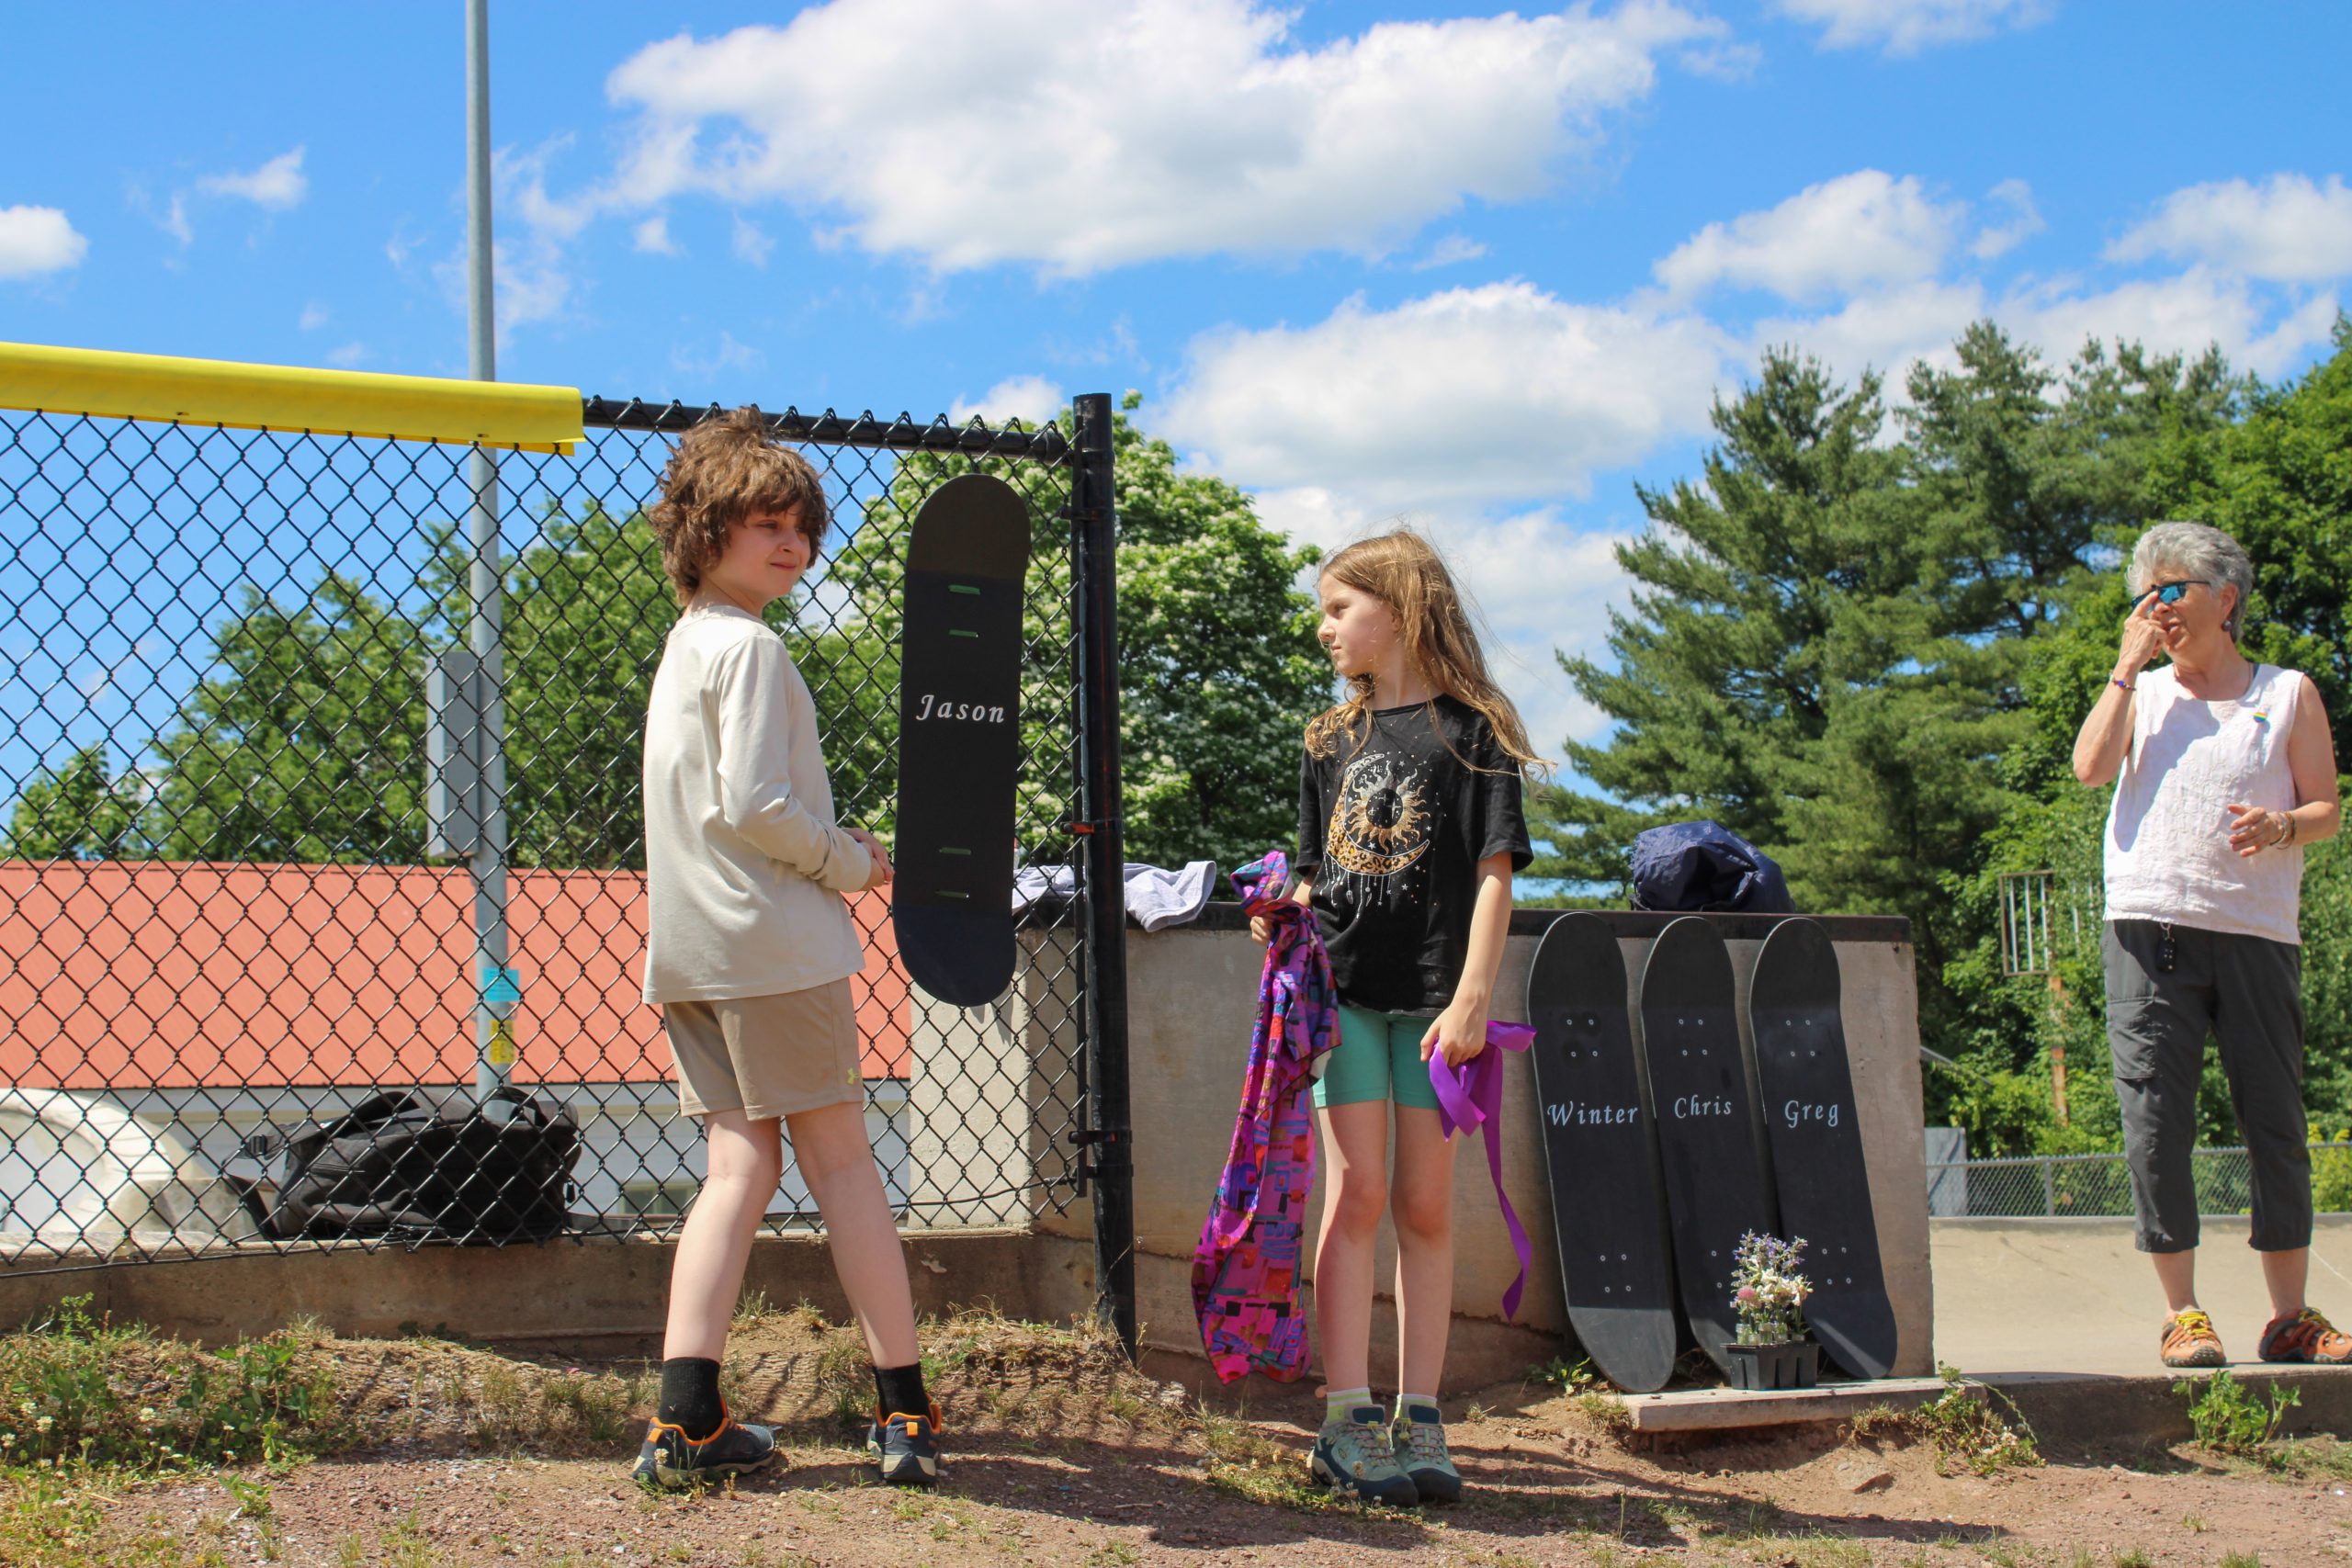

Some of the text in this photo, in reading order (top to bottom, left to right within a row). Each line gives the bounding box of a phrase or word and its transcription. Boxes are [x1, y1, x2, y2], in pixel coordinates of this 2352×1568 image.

[915, 694, 1005, 723] Jason
[1546, 1100, 1638, 1126] Winter
[1674, 1094, 1732, 1119] Chris
[1784, 1100, 1838, 1128] Greg
